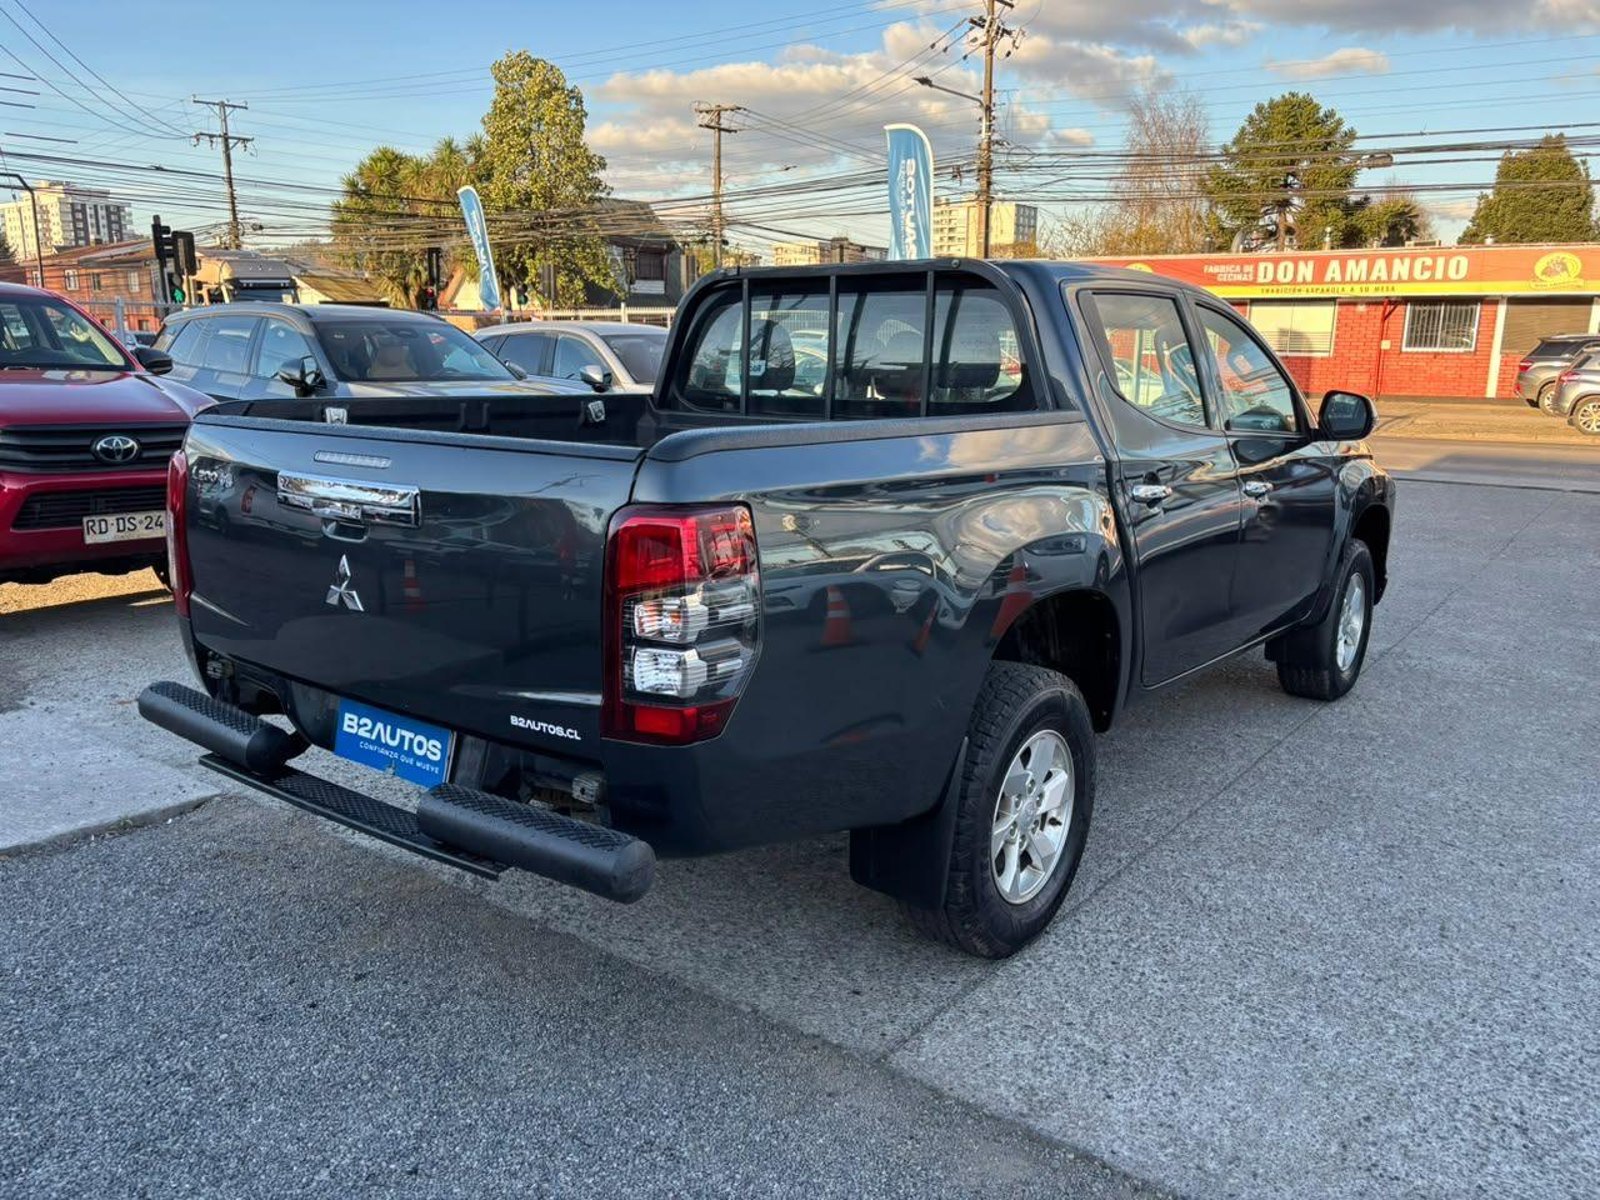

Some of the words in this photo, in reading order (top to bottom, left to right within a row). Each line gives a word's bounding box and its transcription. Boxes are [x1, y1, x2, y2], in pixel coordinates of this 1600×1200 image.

[1257, 260, 1314, 283] DON
[1324, 255, 1469, 283] AMANCIO
[342, 712, 442, 761] B2AUTOS
[509, 714, 582, 741] B2AUTOS.CL
[359, 741, 399, 760] CONFIANZA
[400, 754, 414, 766] QUE
[415, 761, 439, 775] MUEVE
